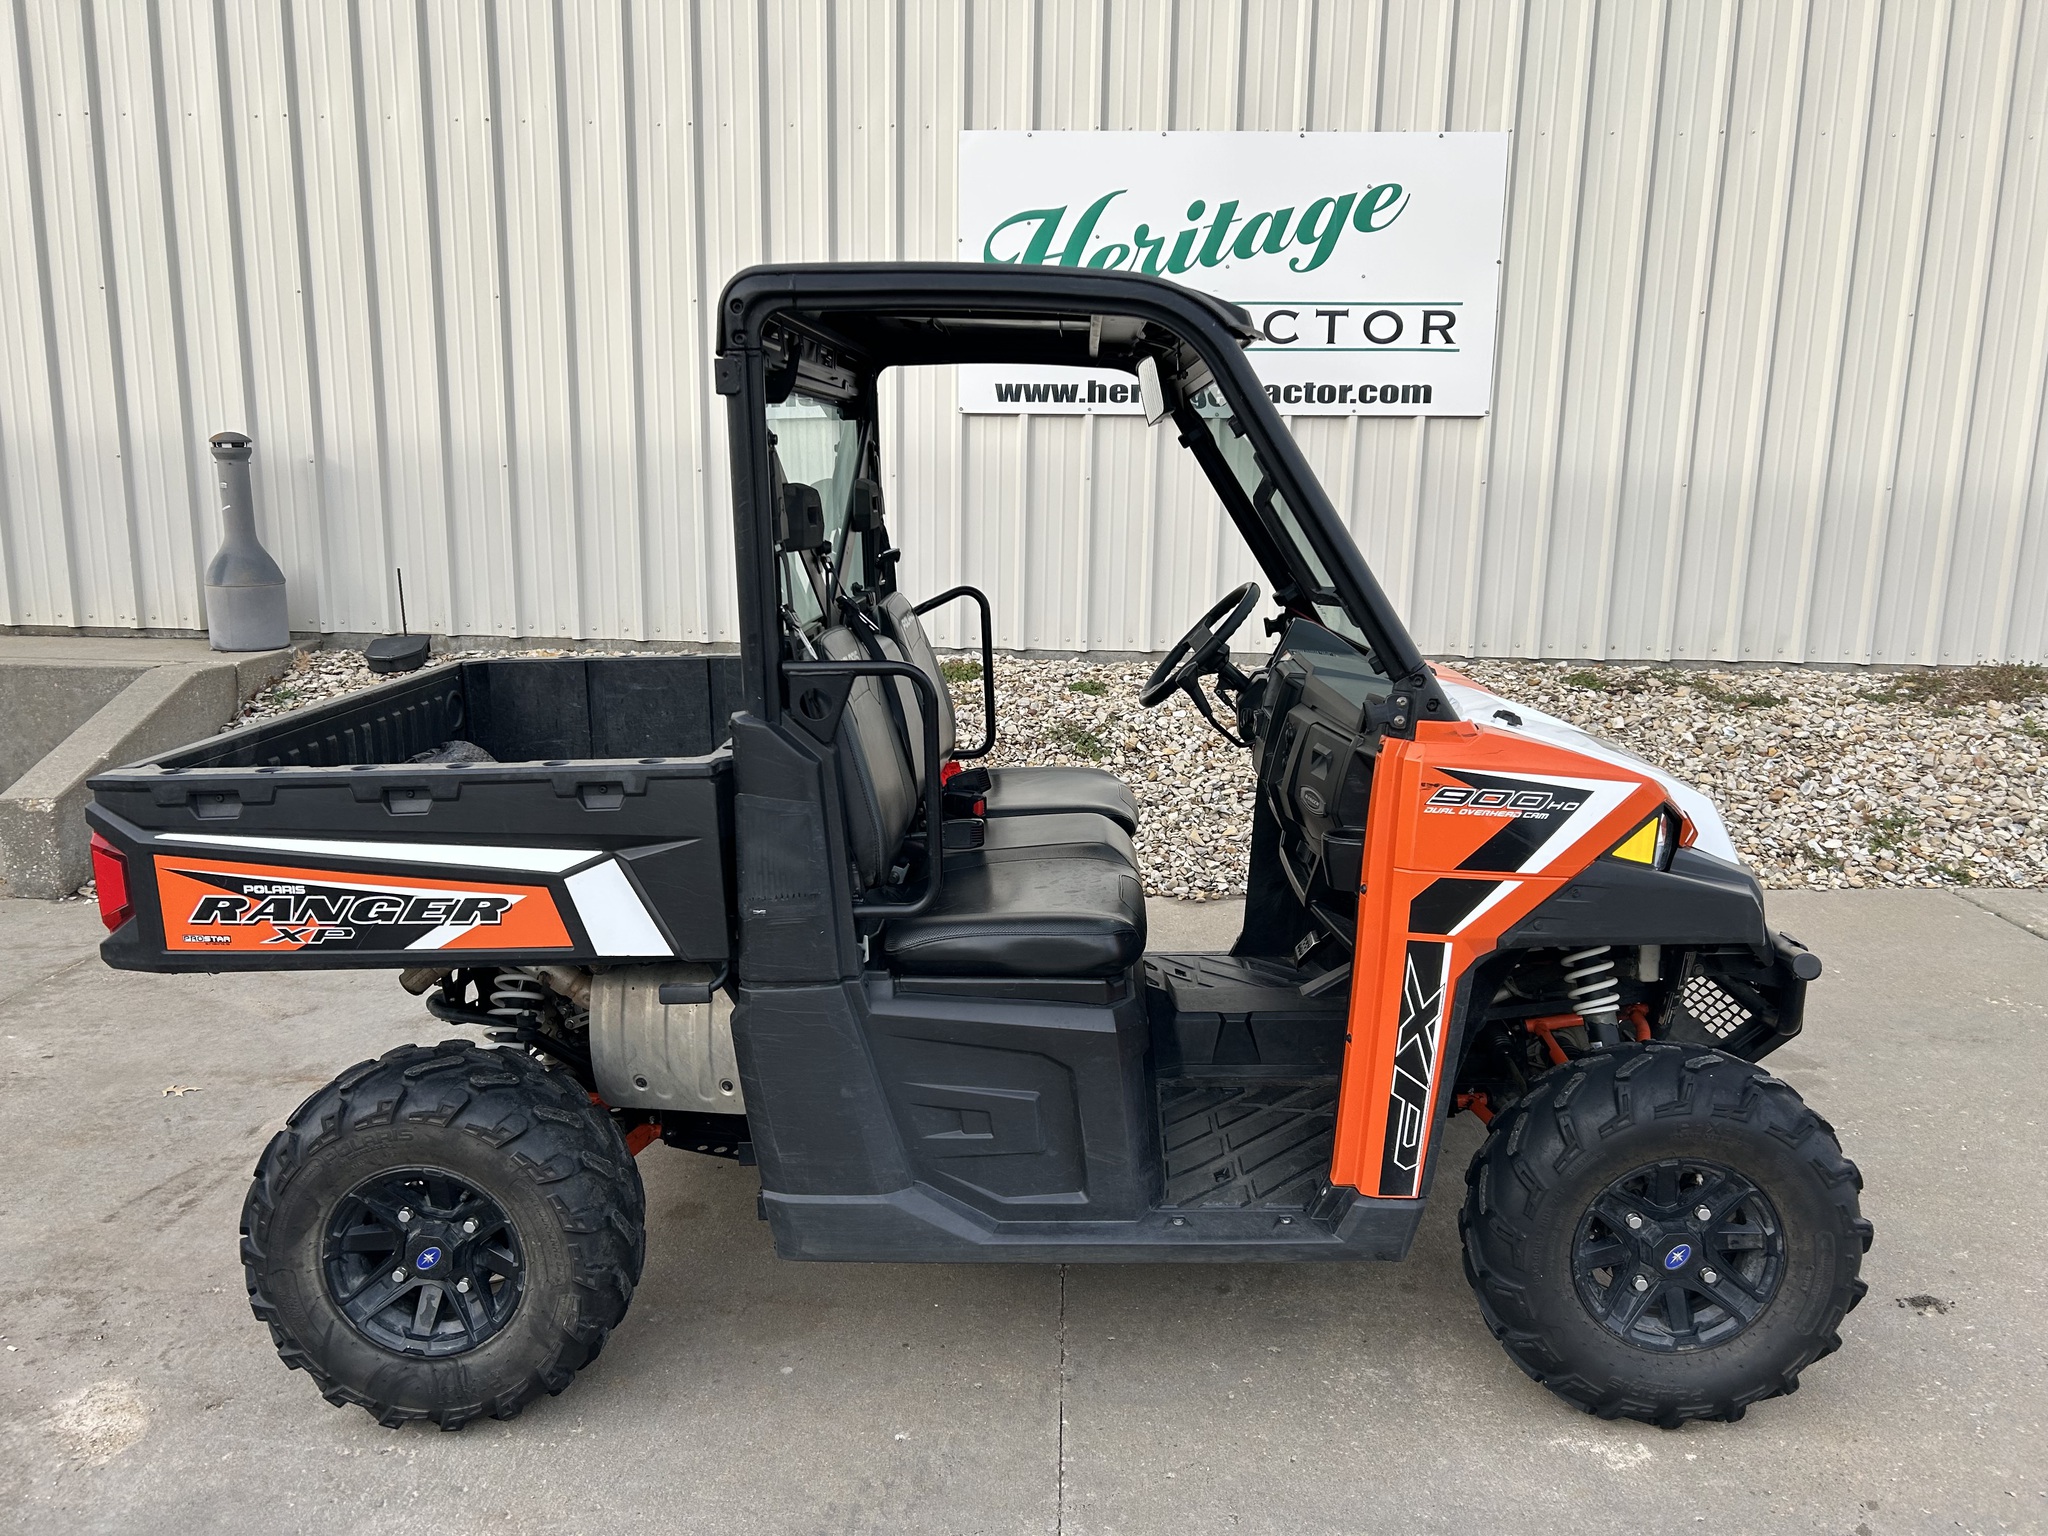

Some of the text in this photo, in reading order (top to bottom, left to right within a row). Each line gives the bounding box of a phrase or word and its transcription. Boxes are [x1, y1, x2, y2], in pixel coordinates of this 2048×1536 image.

[983, 183, 1411, 277] Heritage
[1263, 309, 1457, 344] CTOR
[1424, 807, 1550, 819] DUAL OVERHEAD CAM
[243, 885, 306, 894] POLARIS
[188, 895, 513, 925] RANGER
[183, 935, 231, 943] PROSTAR
[260, 926, 356, 944] XP
[1391, 953, 1446, 1170] XP
